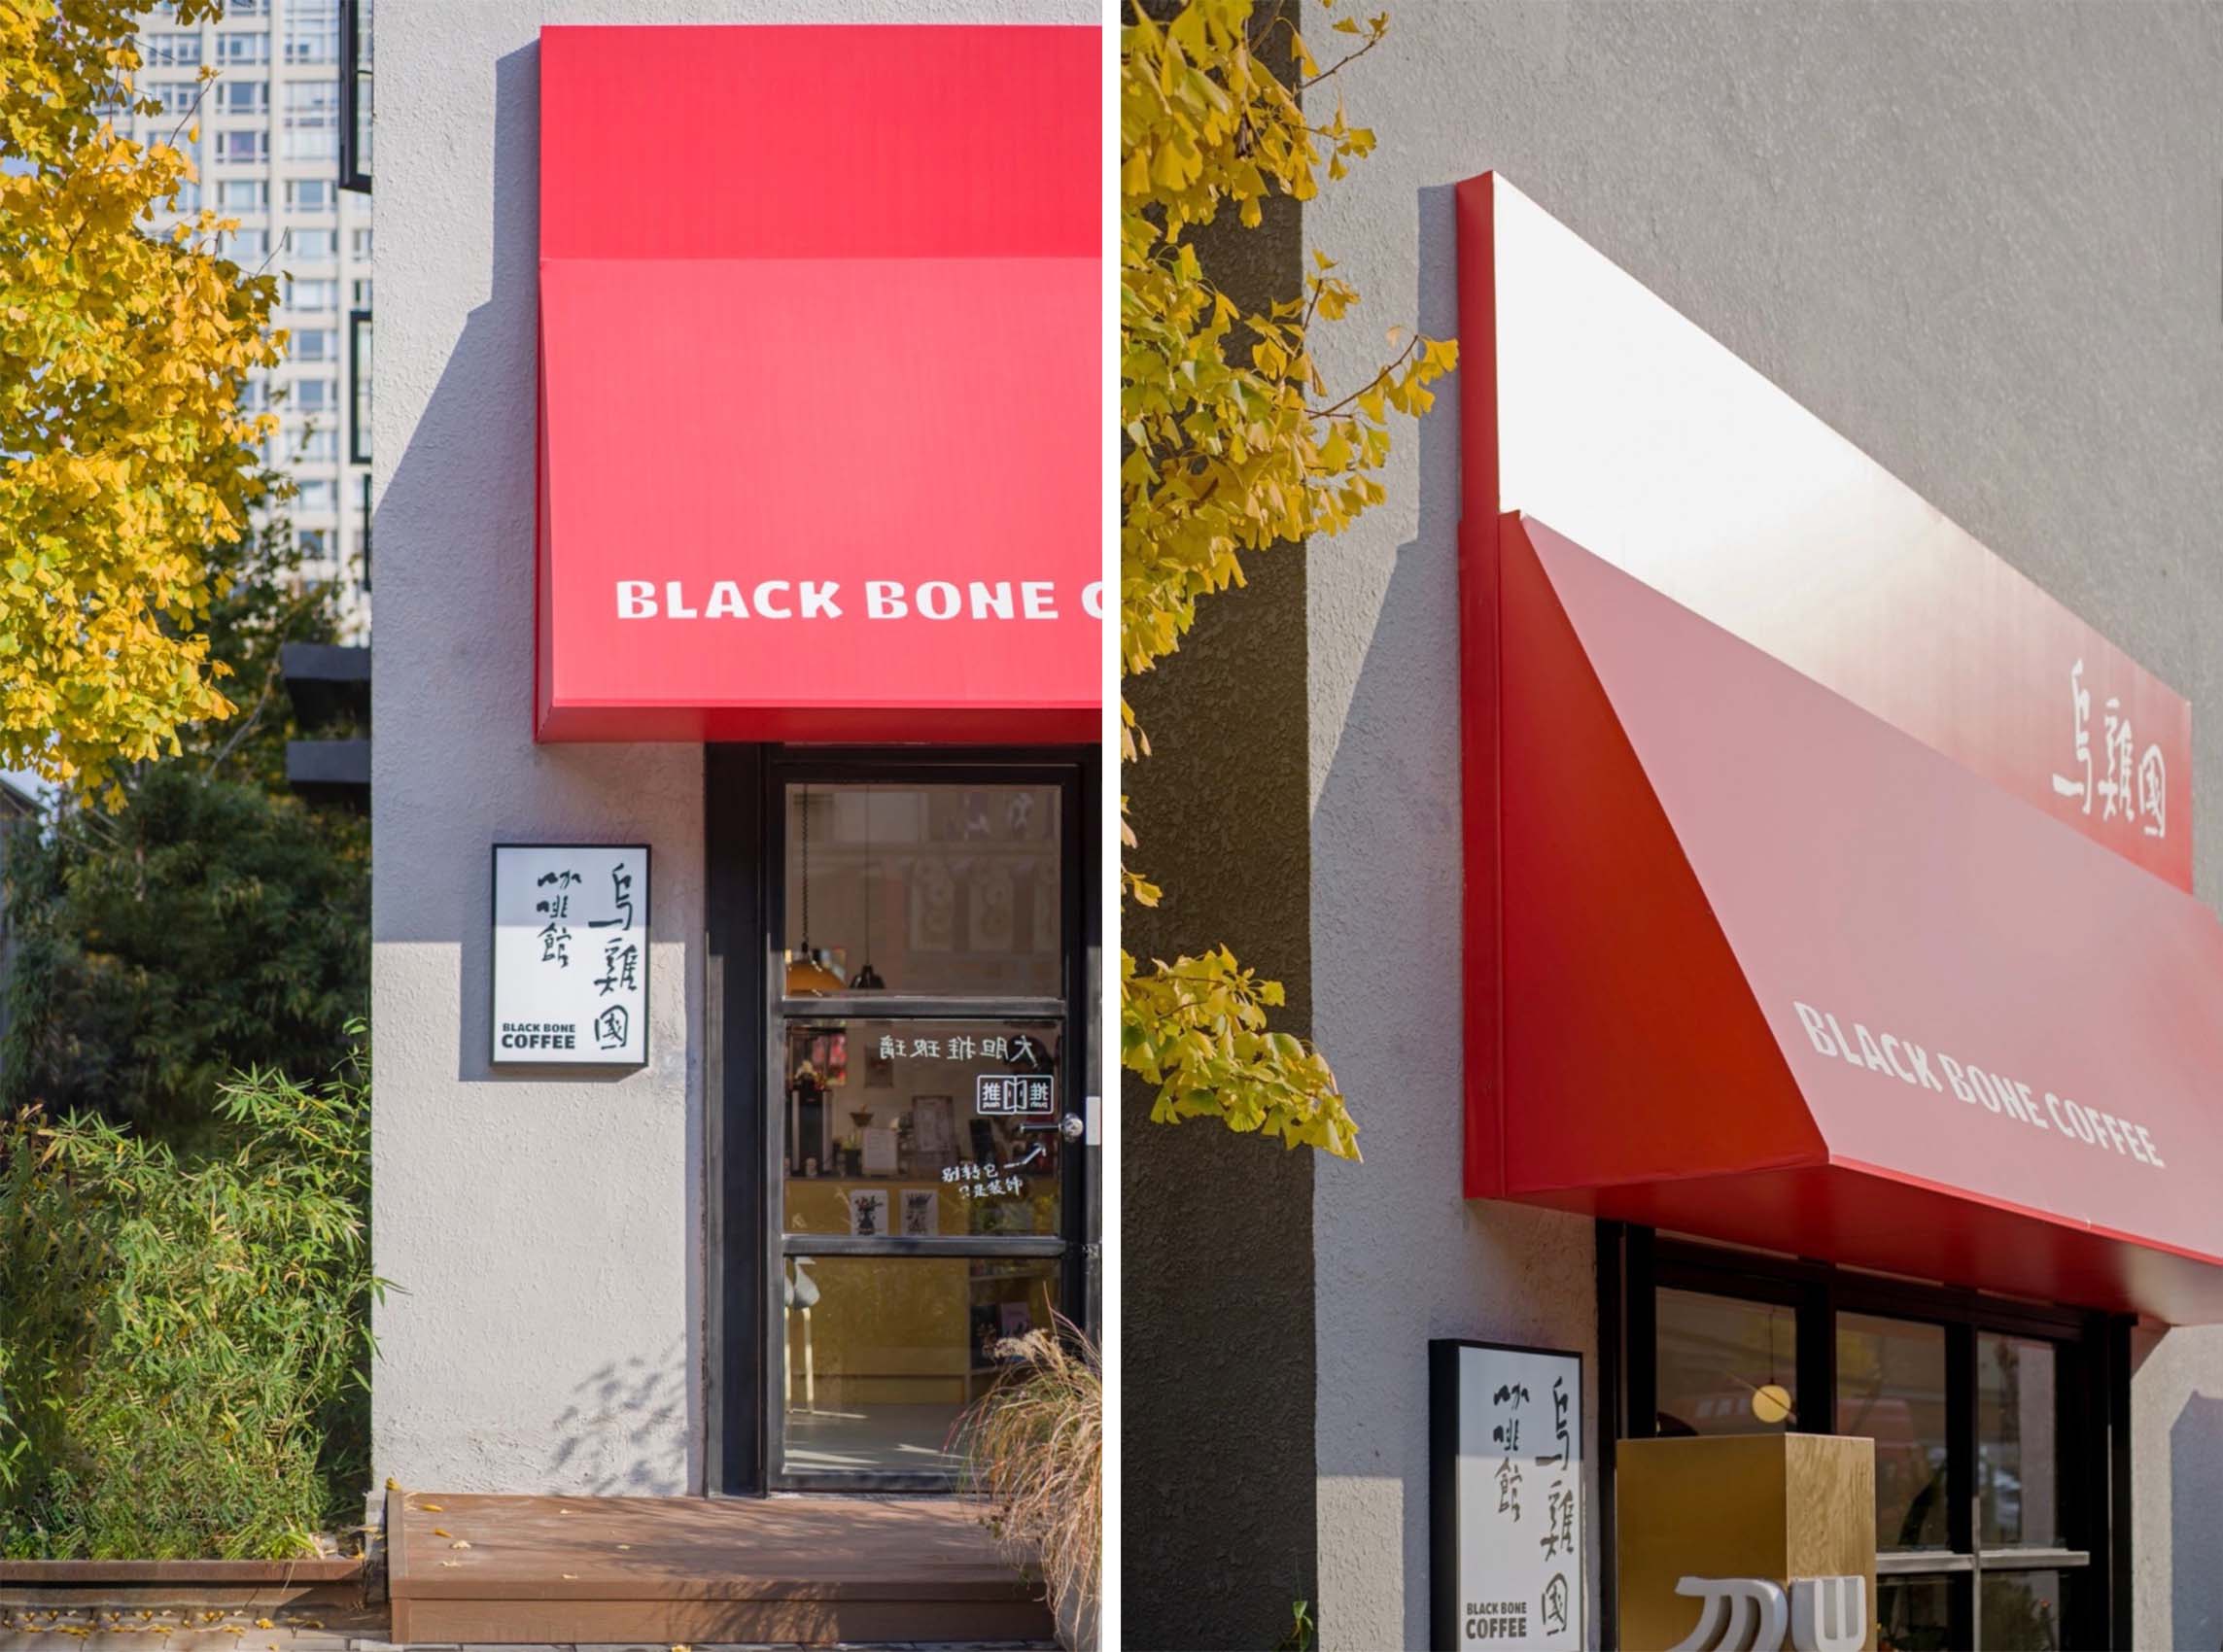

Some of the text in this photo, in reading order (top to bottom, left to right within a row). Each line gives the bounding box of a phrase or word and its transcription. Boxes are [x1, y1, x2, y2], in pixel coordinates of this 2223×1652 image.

[615, 580, 843, 620] BLACK
[864, 580, 1059, 620] BONE
[502, 1022, 575, 1033] BLACK BONE
[502, 1034, 575, 1050] COFFEE
[982, 1082, 1001, 1101] 推
[1793, 1000, 2166, 1167] BLACK BONE COFFEE
[1466, 1601, 1528, 1615] BLACK BONE
[1466, 1617, 1528, 1638] COFFEE
